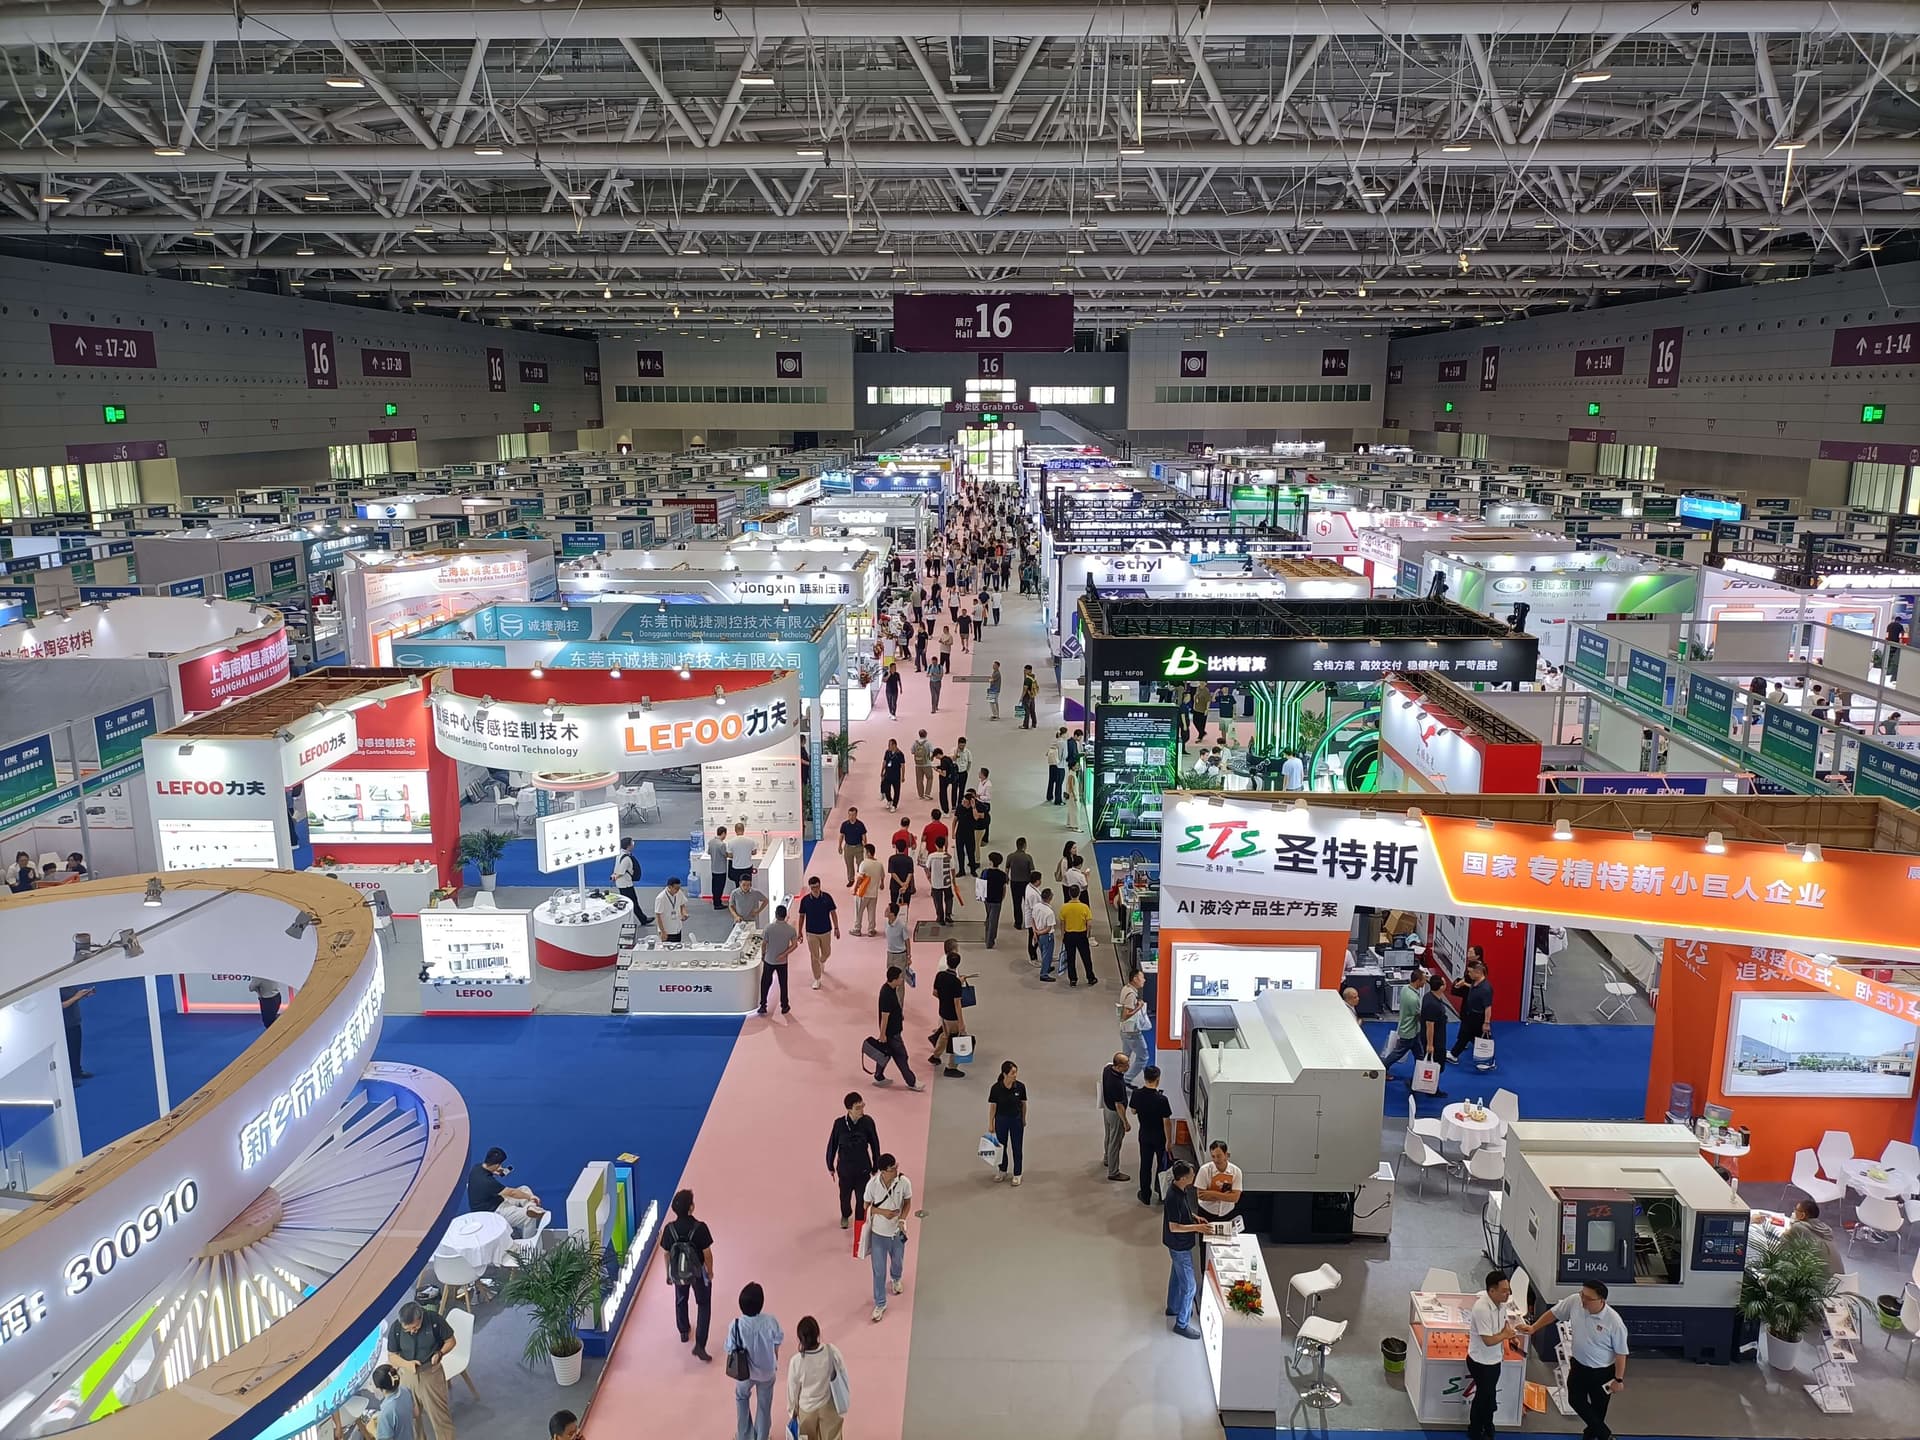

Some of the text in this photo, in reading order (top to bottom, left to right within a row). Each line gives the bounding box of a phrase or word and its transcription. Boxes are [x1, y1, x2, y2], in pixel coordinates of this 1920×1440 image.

[955, 317, 973, 327] 展厅
[976, 303, 1013, 338] 16
[955, 329, 973, 339] Hall
[105, 338, 137, 358] 17-20
[1885, 333, 1911, 354] 1-14
[311, 342, 329, 374] 16
[1656, 340, 1674, 373] 16
[491, 357, 502, 381] 16
[982, 358, 999, 373] 16
[1484, 356, 1495, 381] 16
[982, 403, 1002, 411] Grab
[121, 445, 128, 459] 6
[1866, 446, 1878, 461] 14
[1102, 558, 1162, 573] Methyl
[527, 619, 580, 633] 诚捷测控
[639, 631, 672, 640] Dongguan
[570, 651, 801, 668] 东莞市诚捷测控技术有限公司
[1207, 655, 1267, 673] 比特智算
[1313, 660, 1355, 671] 全栈方案
[1360, 660, 1402, 671] 高效交付
[1407, 660, 1450, 671] 稳健护航
[211, 677, 248, 698] SHANGHAI
[249, 670, 269, 684] NANJI
[436, 703, 580, 741] 数据中心传感控制技术
[461, 737, 487, 751] Sensing
[489, 742, 520, 753] Control
[522, 744, 579, 758] Technology
[1176, 820, 1419, 886] STS 圣特斯
[1205, 864, 1234, 874] 圣特斯
[1462, 851, 1827, 909] 国家 专精特新 小巨人企业
[1177, 900, 1338, 918] AI 液冷产品生产方案
[456, 989, 493, 998] LEFOO
[659, 984, 713, 993] LEFOO力夫
[64, 1177, 199, 1296] 300910
[1585, 1263, 1609, 1272] HX46
